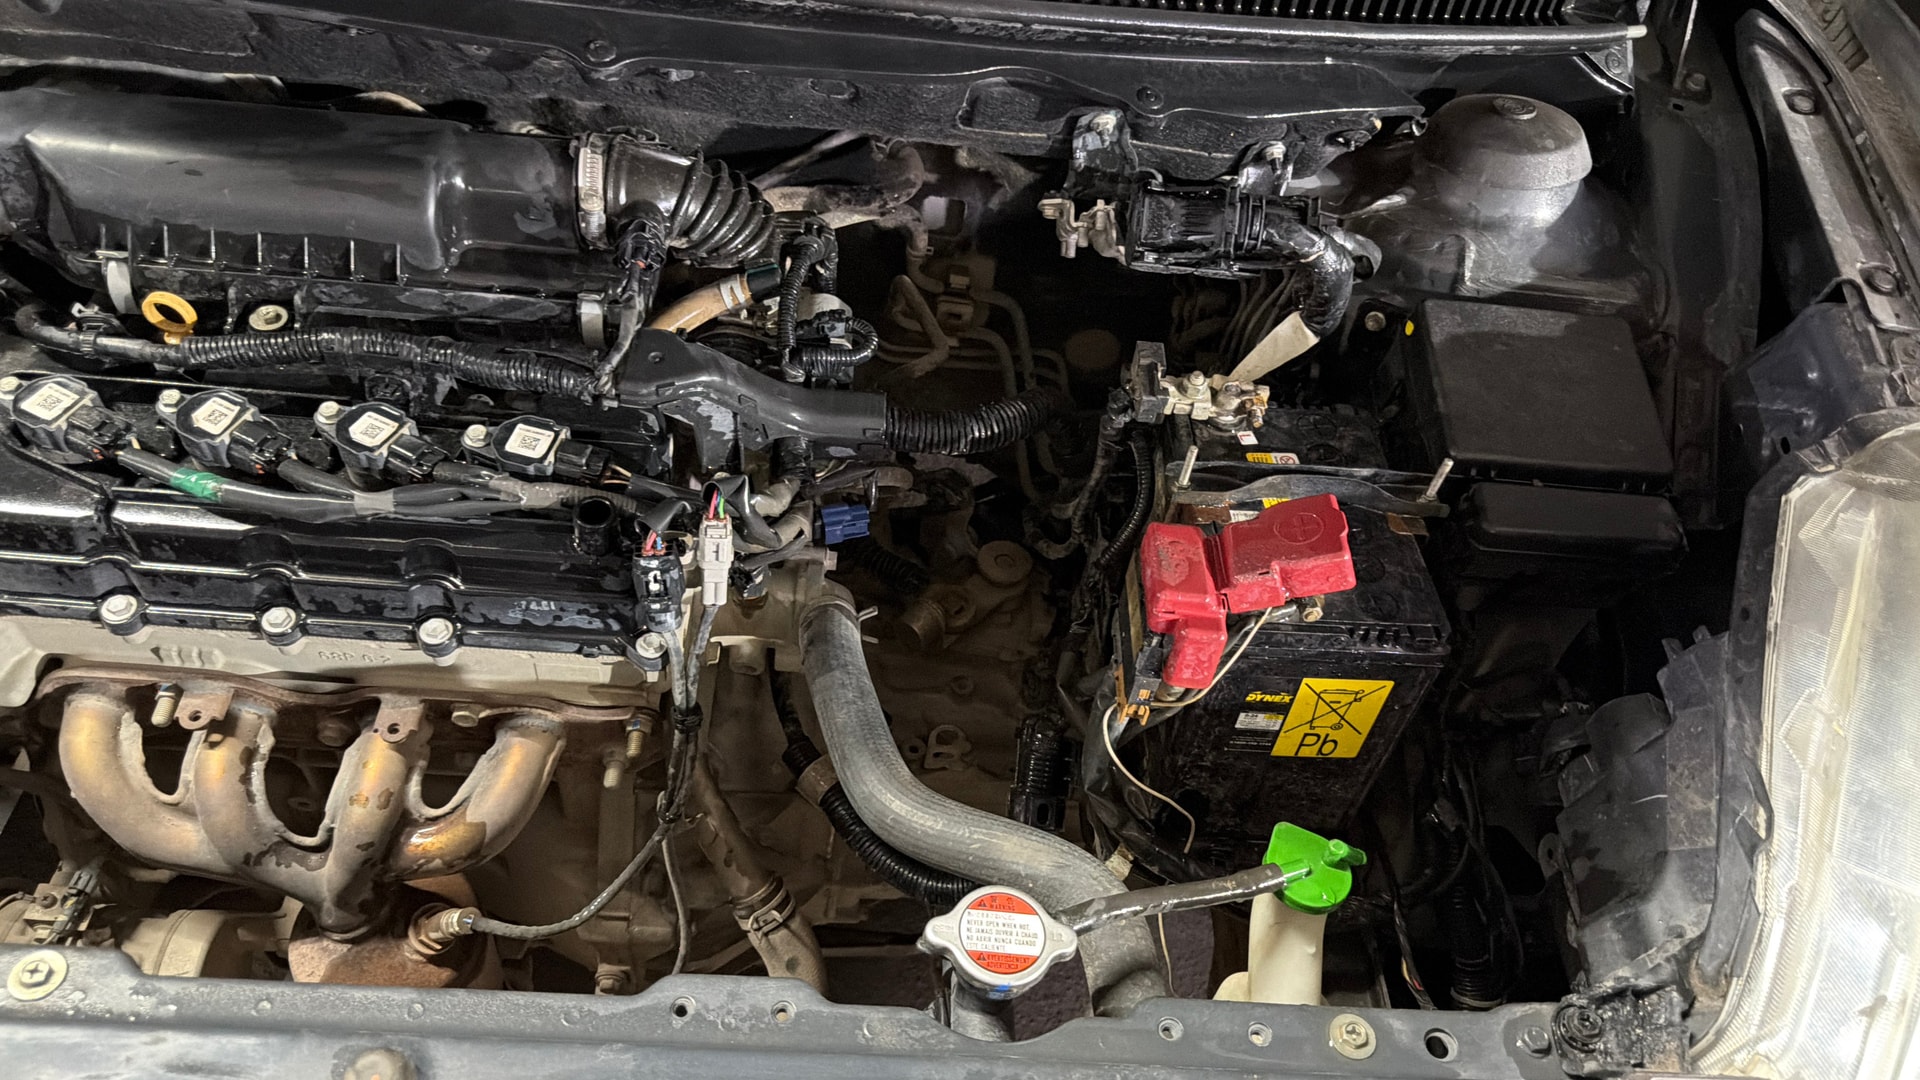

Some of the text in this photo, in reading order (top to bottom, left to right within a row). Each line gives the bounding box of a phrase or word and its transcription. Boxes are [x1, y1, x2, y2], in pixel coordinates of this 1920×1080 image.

[1245, 693, 1294, 703] DYNEX
[1295, 733, 1339, 757] Pb
[985, 920, 1000, 928] OPEN
[975, 927, 993, 935] JAMAIS
[1021, 931, 1038, 939] CHAUD
[994, 937, 1012, 945] NUNCA
[1014, 938, 1036, 947] CUANDO
